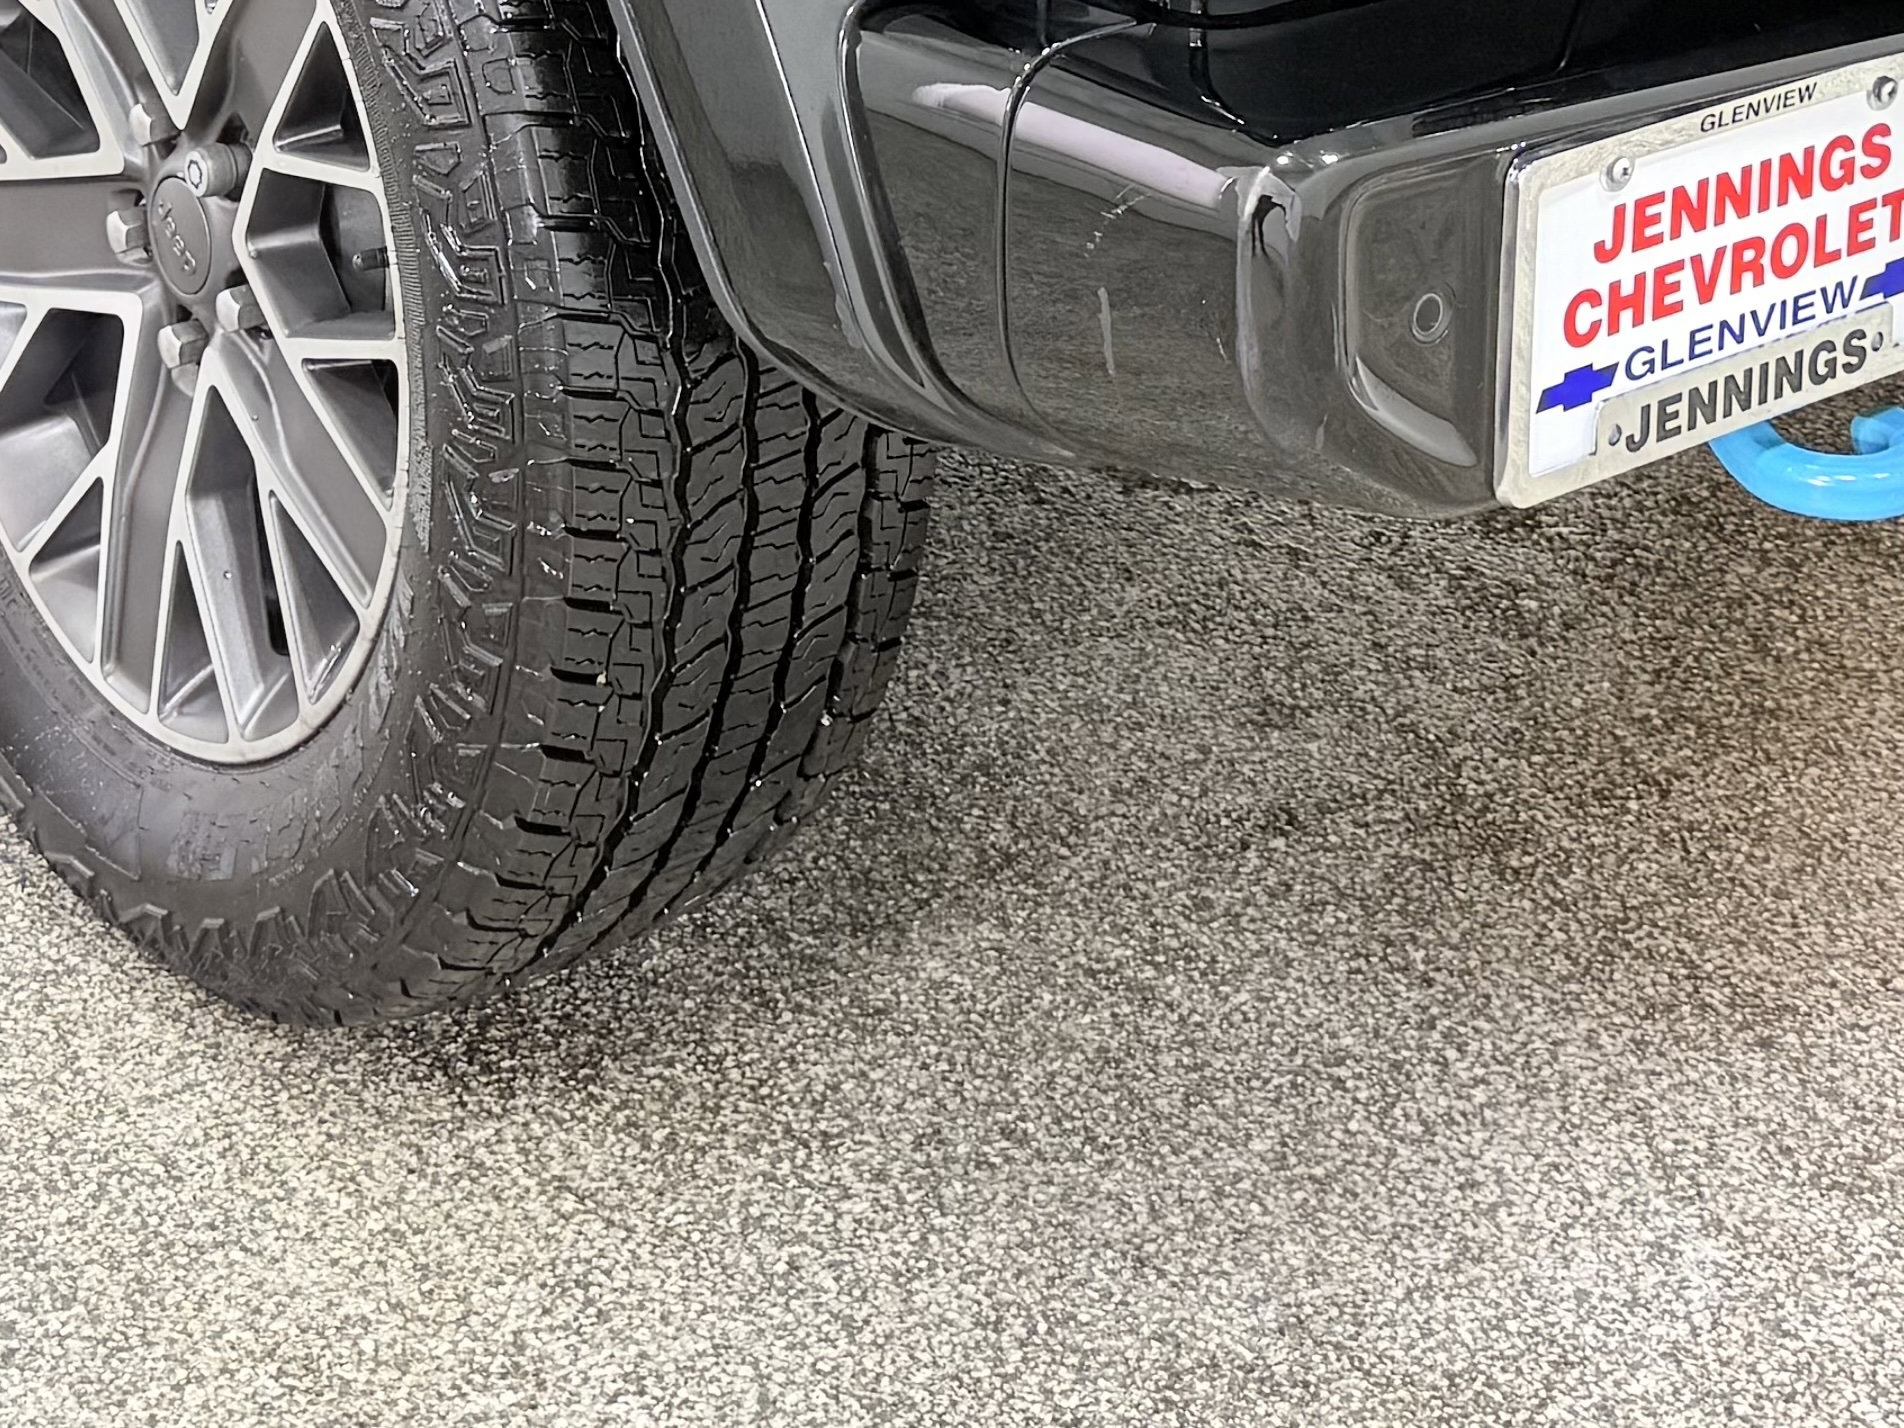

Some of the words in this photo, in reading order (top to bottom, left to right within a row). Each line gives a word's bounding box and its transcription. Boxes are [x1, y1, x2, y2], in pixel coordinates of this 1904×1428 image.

[1700, 82, 1817, 133] GLENVIEW
[1595, 123, 1892, 264] JENNINGS
[1625, 276, 1859, 382] GLENVIEW
[1626, 328, 1868, 453] JENNINGS
